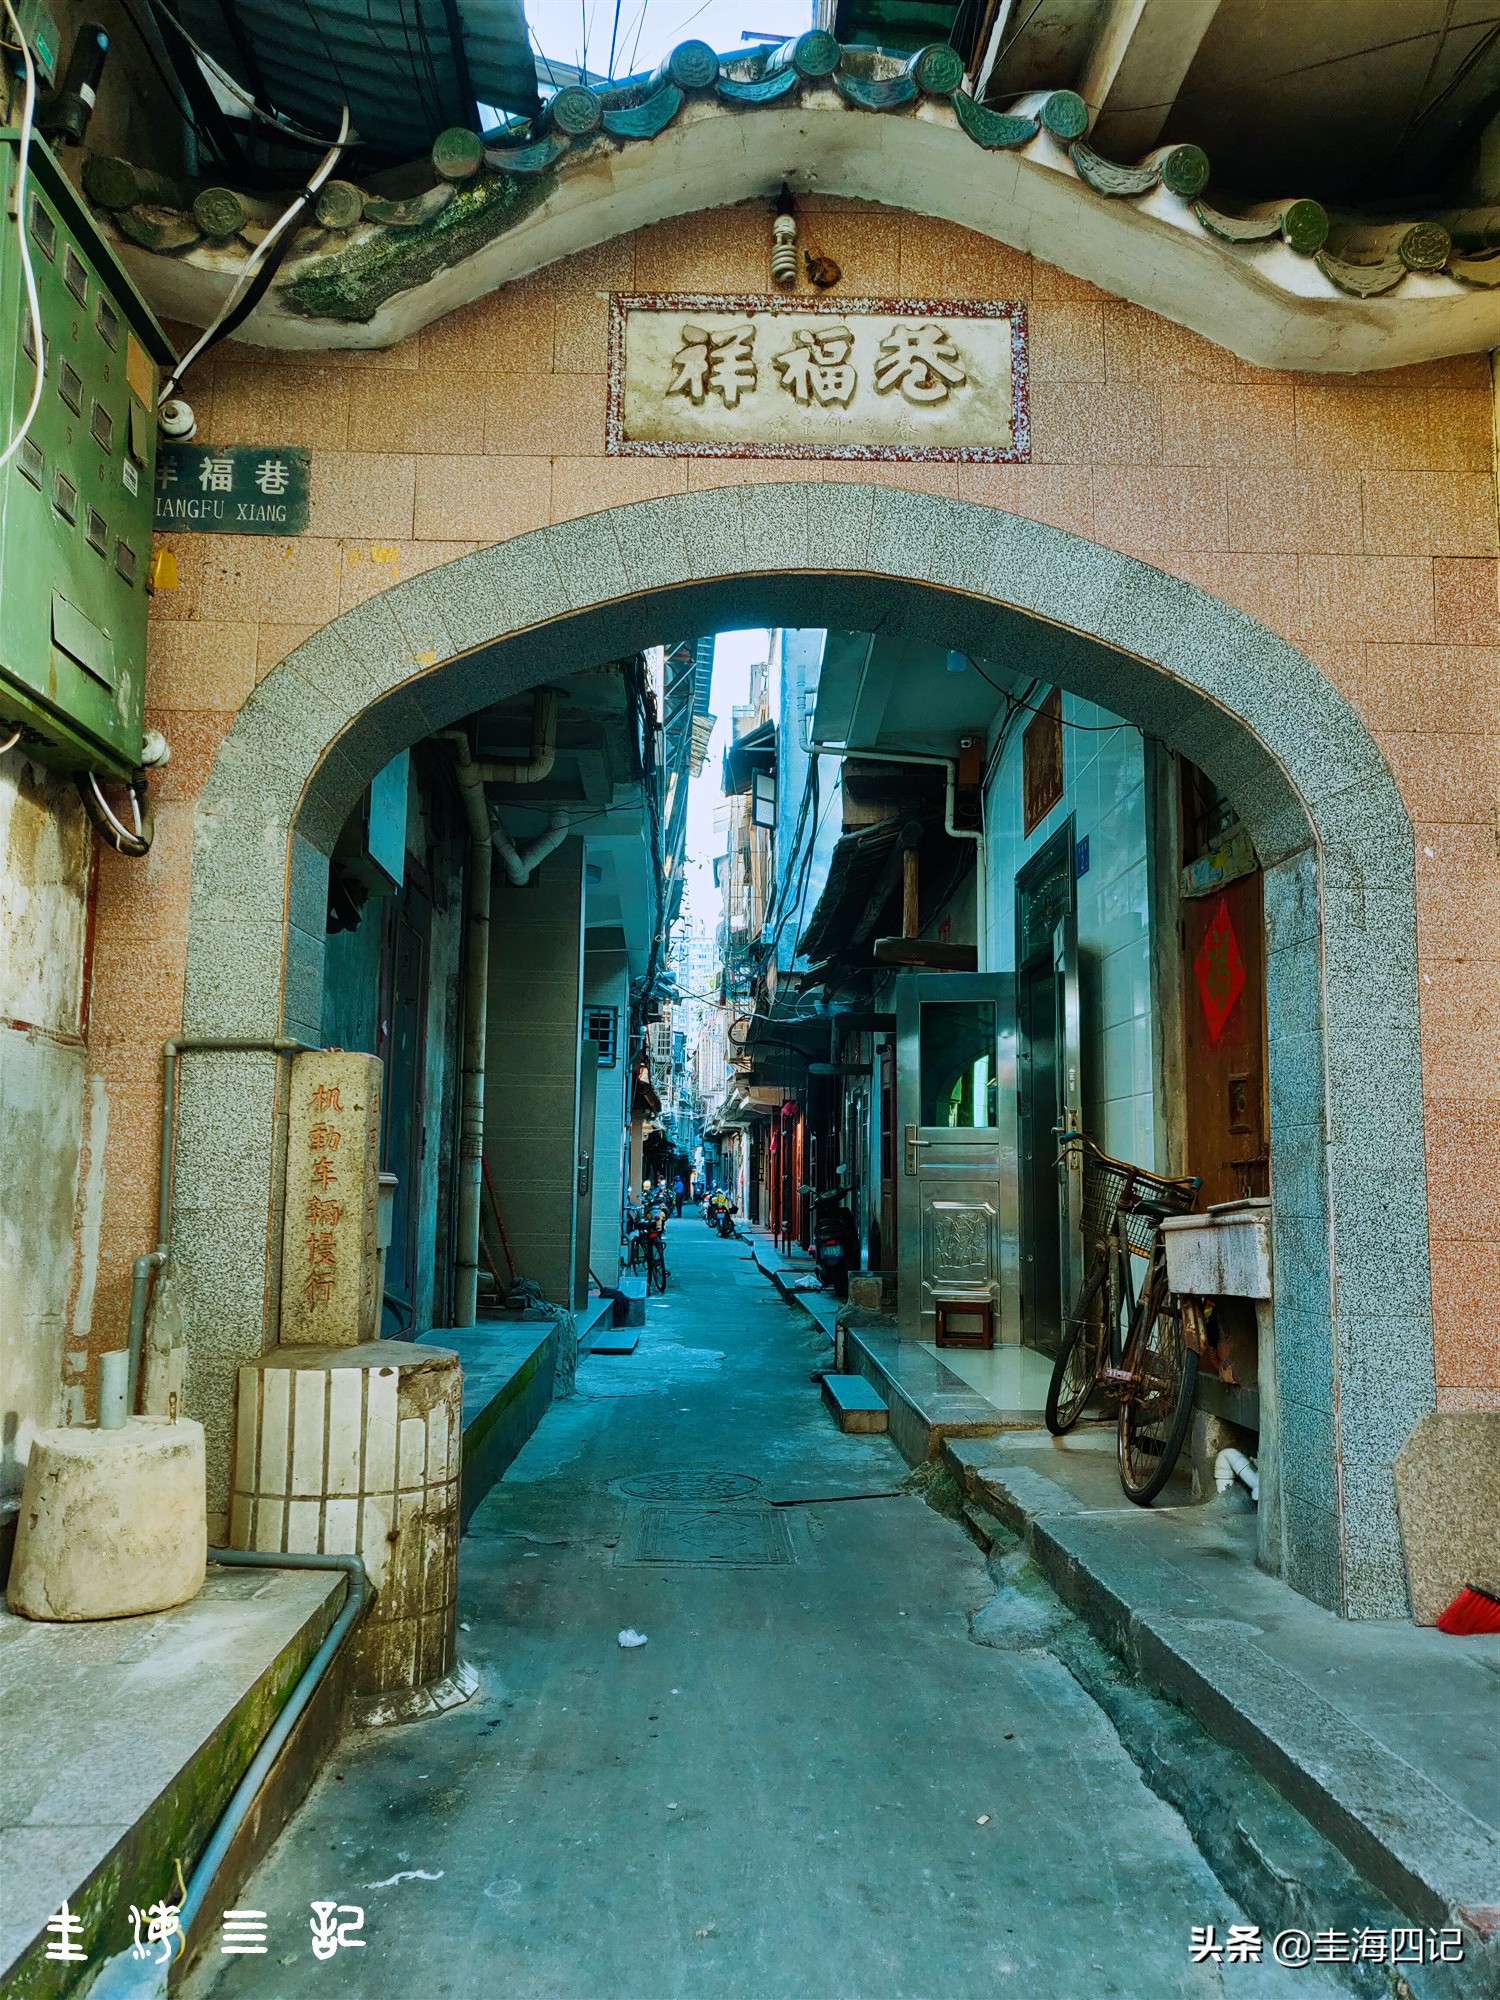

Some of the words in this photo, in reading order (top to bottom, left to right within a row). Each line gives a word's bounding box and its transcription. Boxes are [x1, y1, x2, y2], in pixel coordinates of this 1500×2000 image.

[665, 323, 968, 410] 祥福巷
[236, 503, 287, 522] XIANG
